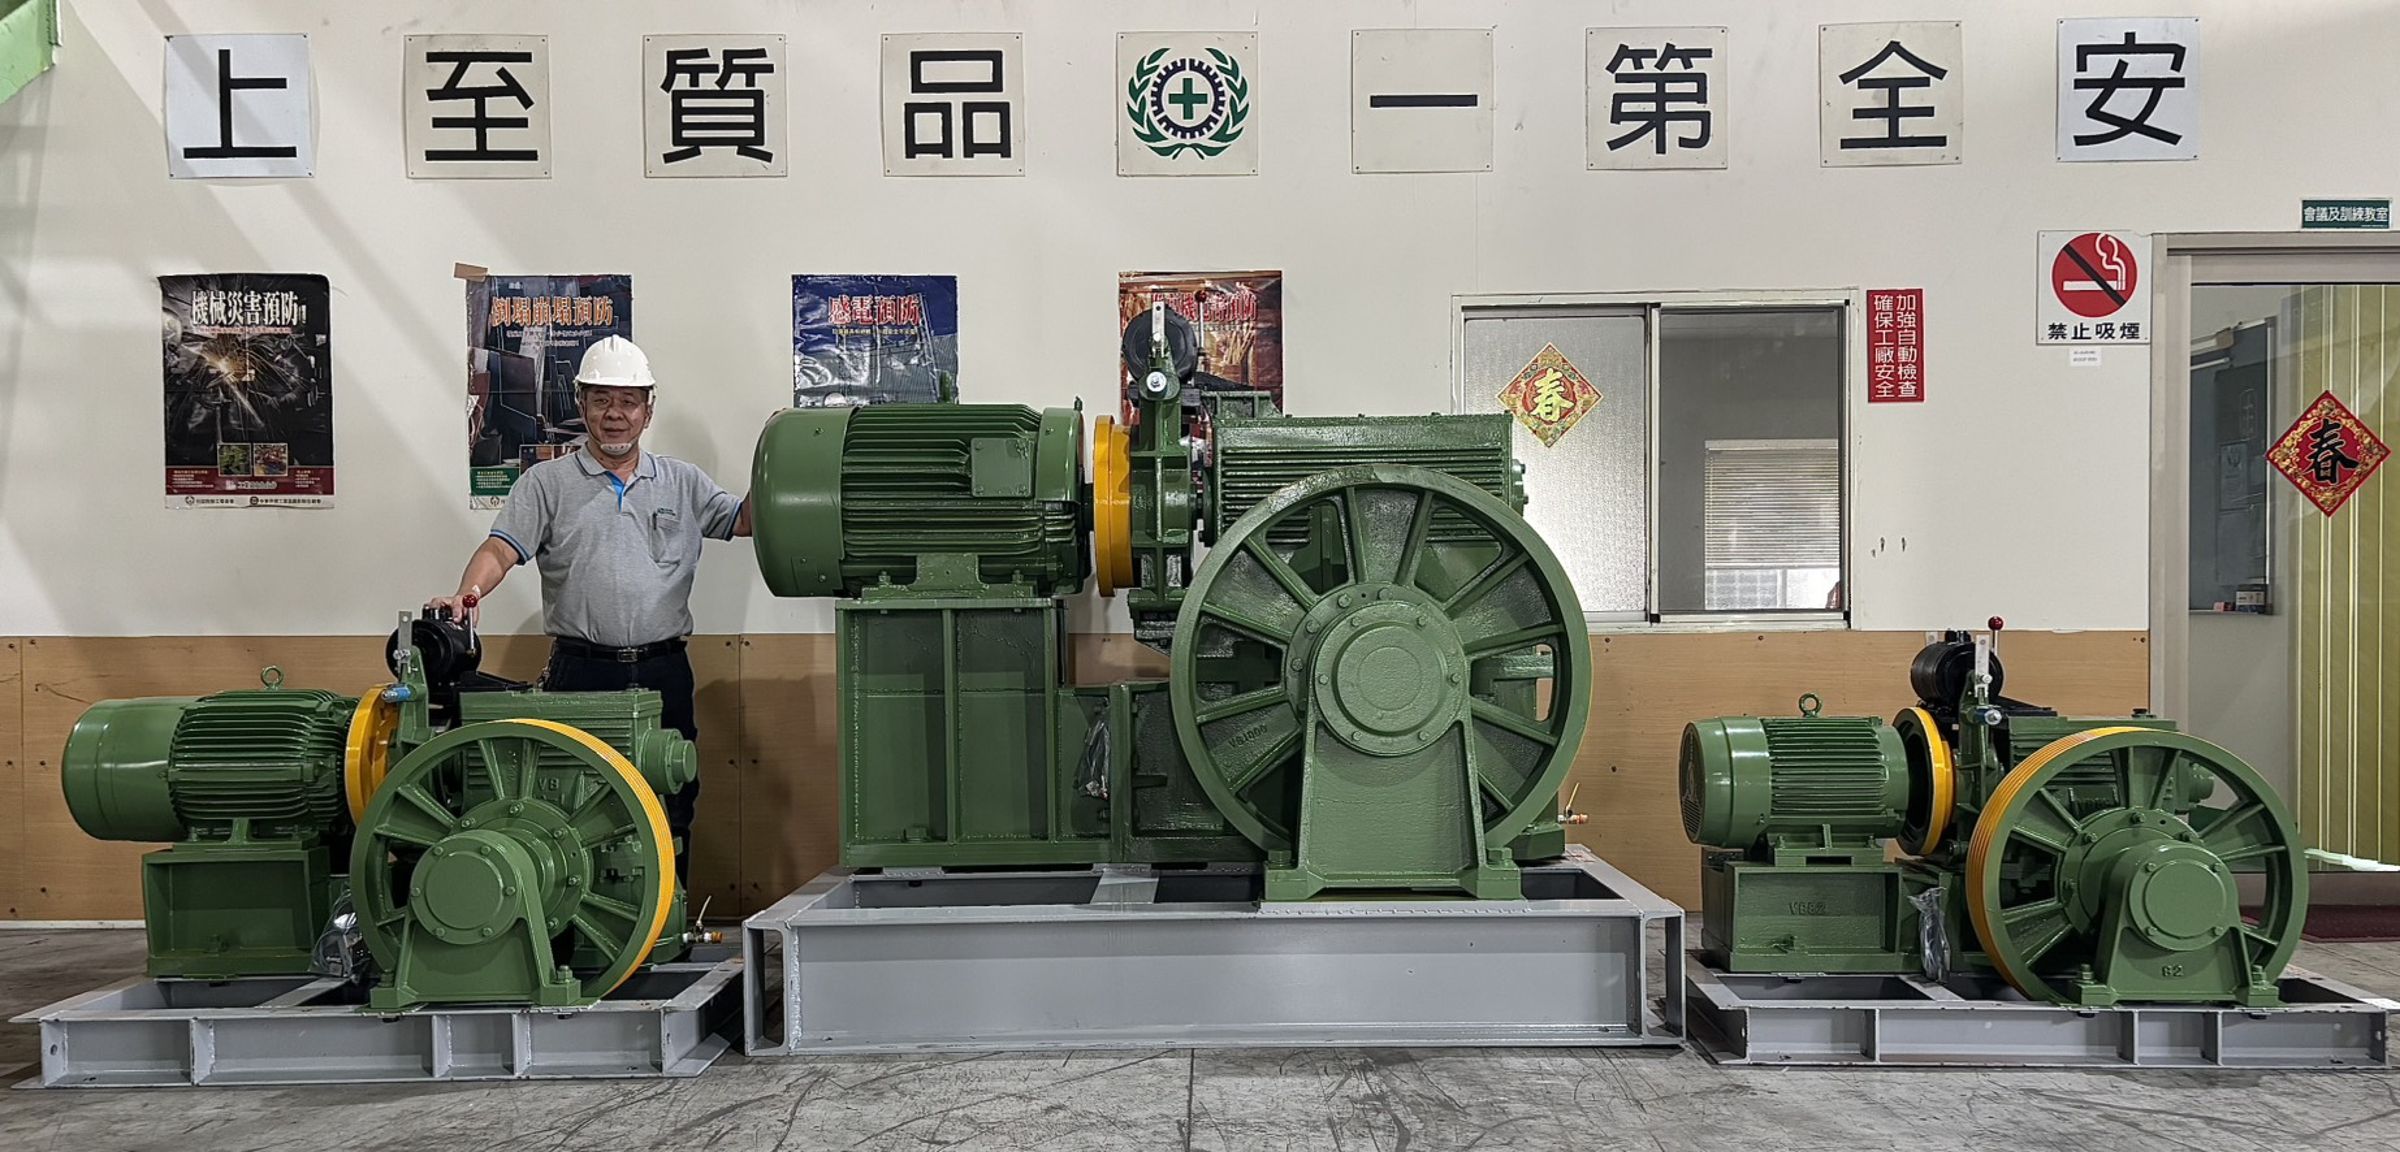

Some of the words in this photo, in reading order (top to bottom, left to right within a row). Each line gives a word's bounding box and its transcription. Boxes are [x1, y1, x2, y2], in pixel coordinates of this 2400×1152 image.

[184, 50, 296, 158] 上
[425, 52, 538, 161] 至
[661, 48, 774, 163] 質
[904, 51, 1011, 158] 品
[1371, 95, 1477, 107] 一
[1606, 43, 1712, 154] 第
[1839, 41, 1947, 149] 全
[2074, 32, 2186, 146] 安
[2303, 206, 2388, 222] 會議及訓練教室
[828, 294, 921, 326] 感電預防
[1873, 294, 1895, 398] 確保工廠安全
[1896, 294, 1917, 398] 加強自動檢查
[2048, 322, 2140, 340] 禁止吸煙
[1531, 367, 1575, 422] 春
[2302, 418, 2360, 485] 春
